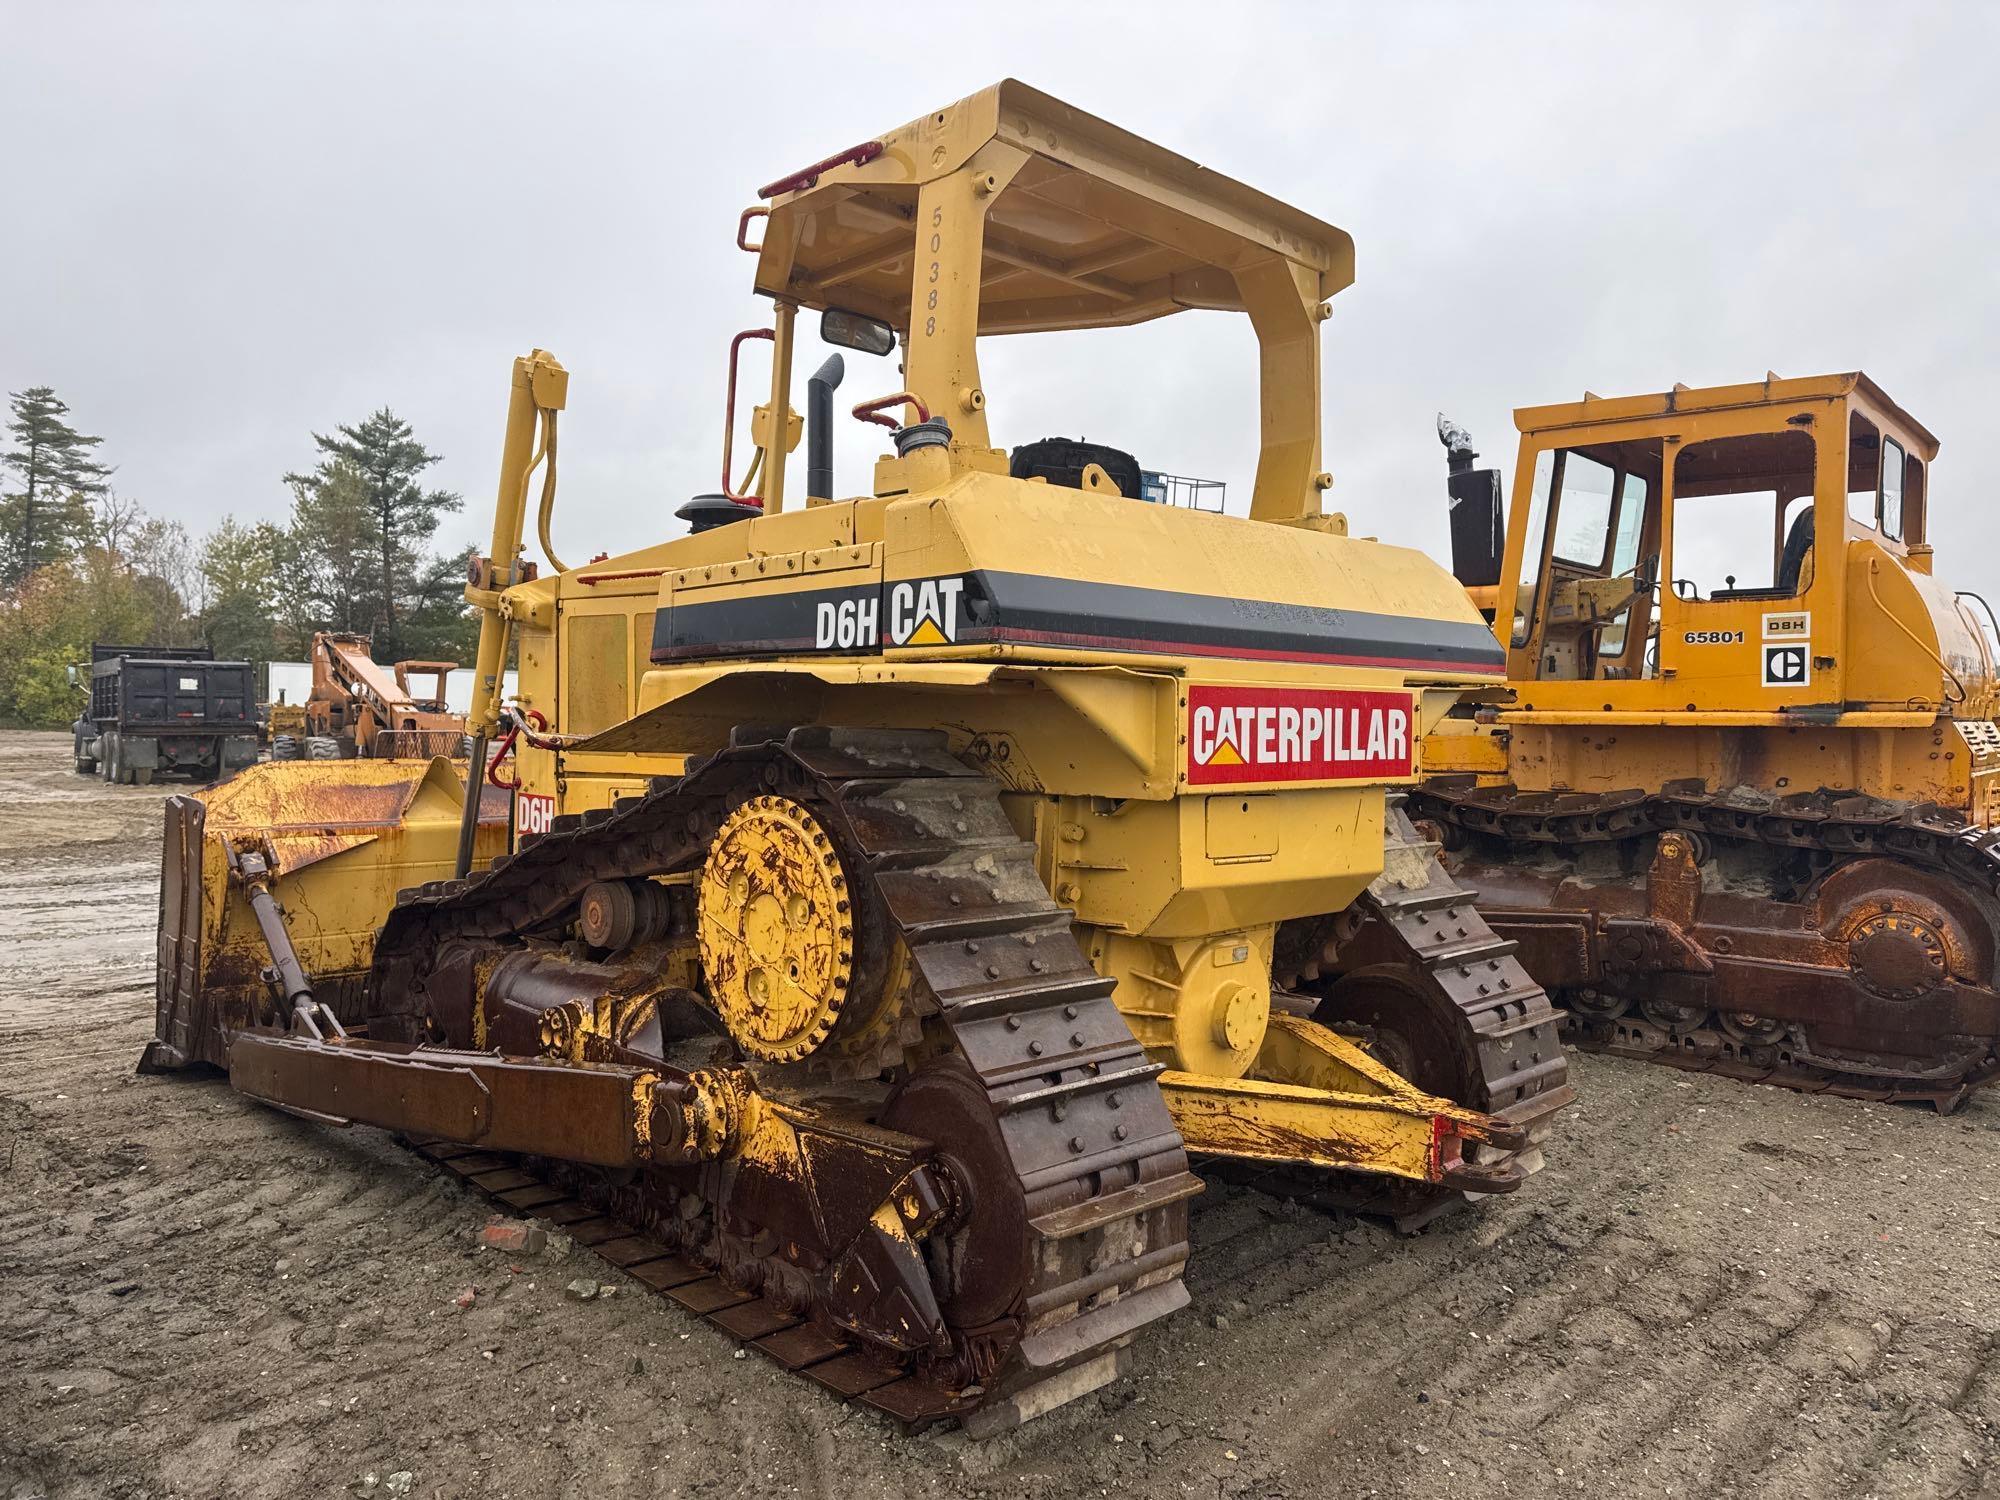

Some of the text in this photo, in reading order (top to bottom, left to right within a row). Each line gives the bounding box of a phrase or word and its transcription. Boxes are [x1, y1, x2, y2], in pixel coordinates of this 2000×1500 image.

[925, 205, 942, 337] 50388
[815, 598, 878, 649] D6H
[891, 578, 963, 645] CAT
[1769, 621, 1804, 631] D8H
[1684, 631, 1745, 644] 65801
[1193, 705, 1407, 766] CATERPILLAR
[518, 796, 554, 834] D6H
